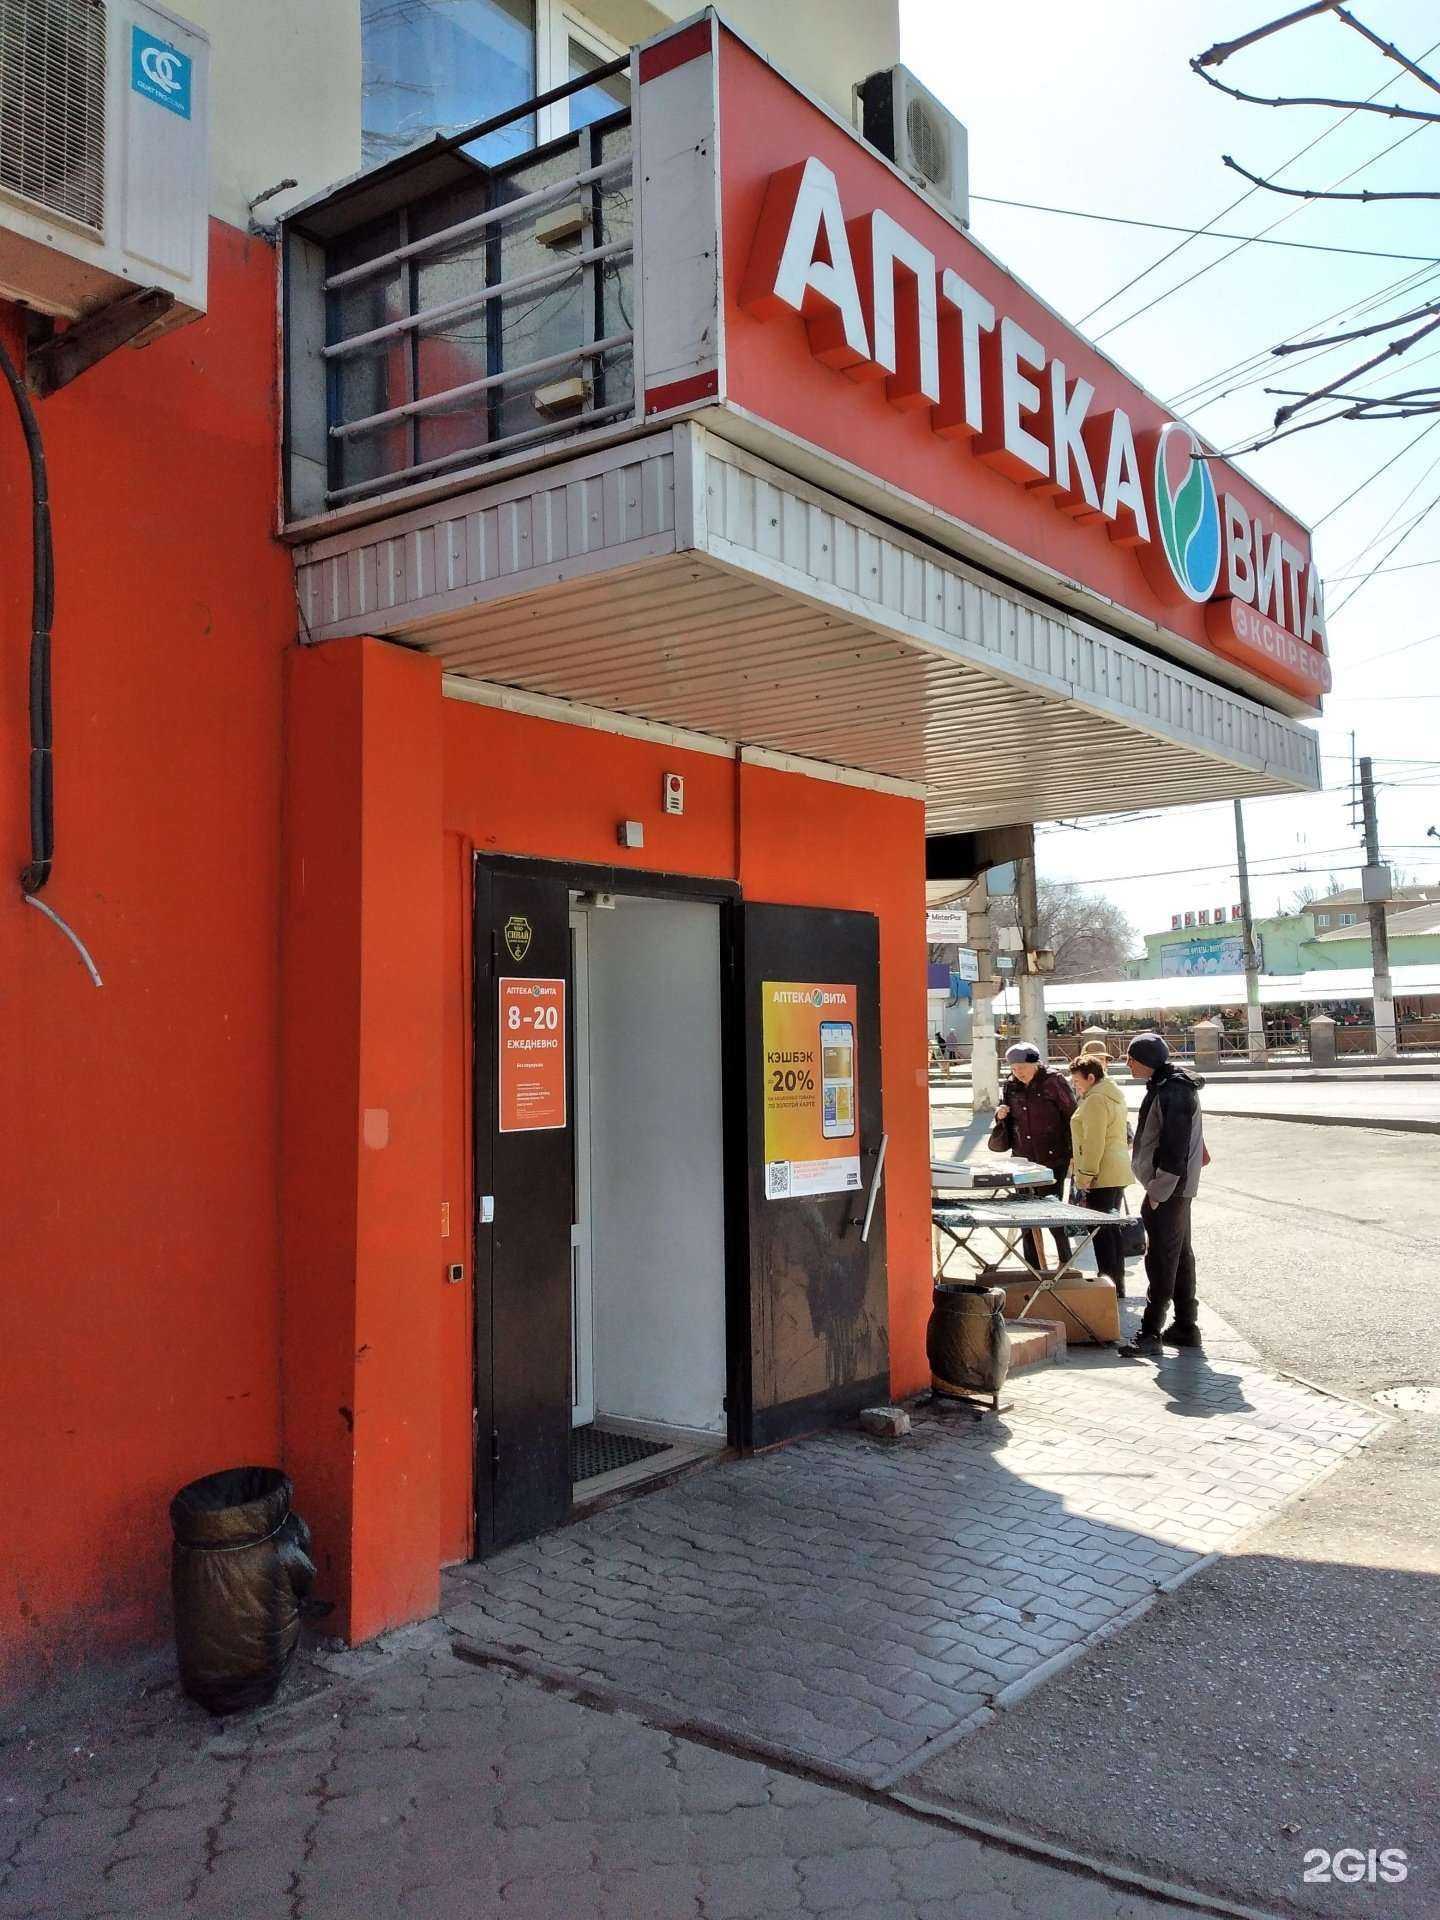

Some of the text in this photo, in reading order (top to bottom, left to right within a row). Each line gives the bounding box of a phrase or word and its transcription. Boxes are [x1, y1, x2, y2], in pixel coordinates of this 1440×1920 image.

[774, 156, 1330, 658] АПТЕКА ВИТА
[1236, 606, 1332, 692] ЭКСПРЕСС
[506, 986, 557, 995] АПТЕКА ВИТА
[773, 991, 847, 1004] АПТЕКА ВИТА
[507, 1040, 558, 1050] ЕЖЕДНЕВНО
[767, 1051, 814, 1063] КЭШБЭК
[773, 1070, 814, 1091] 20%
